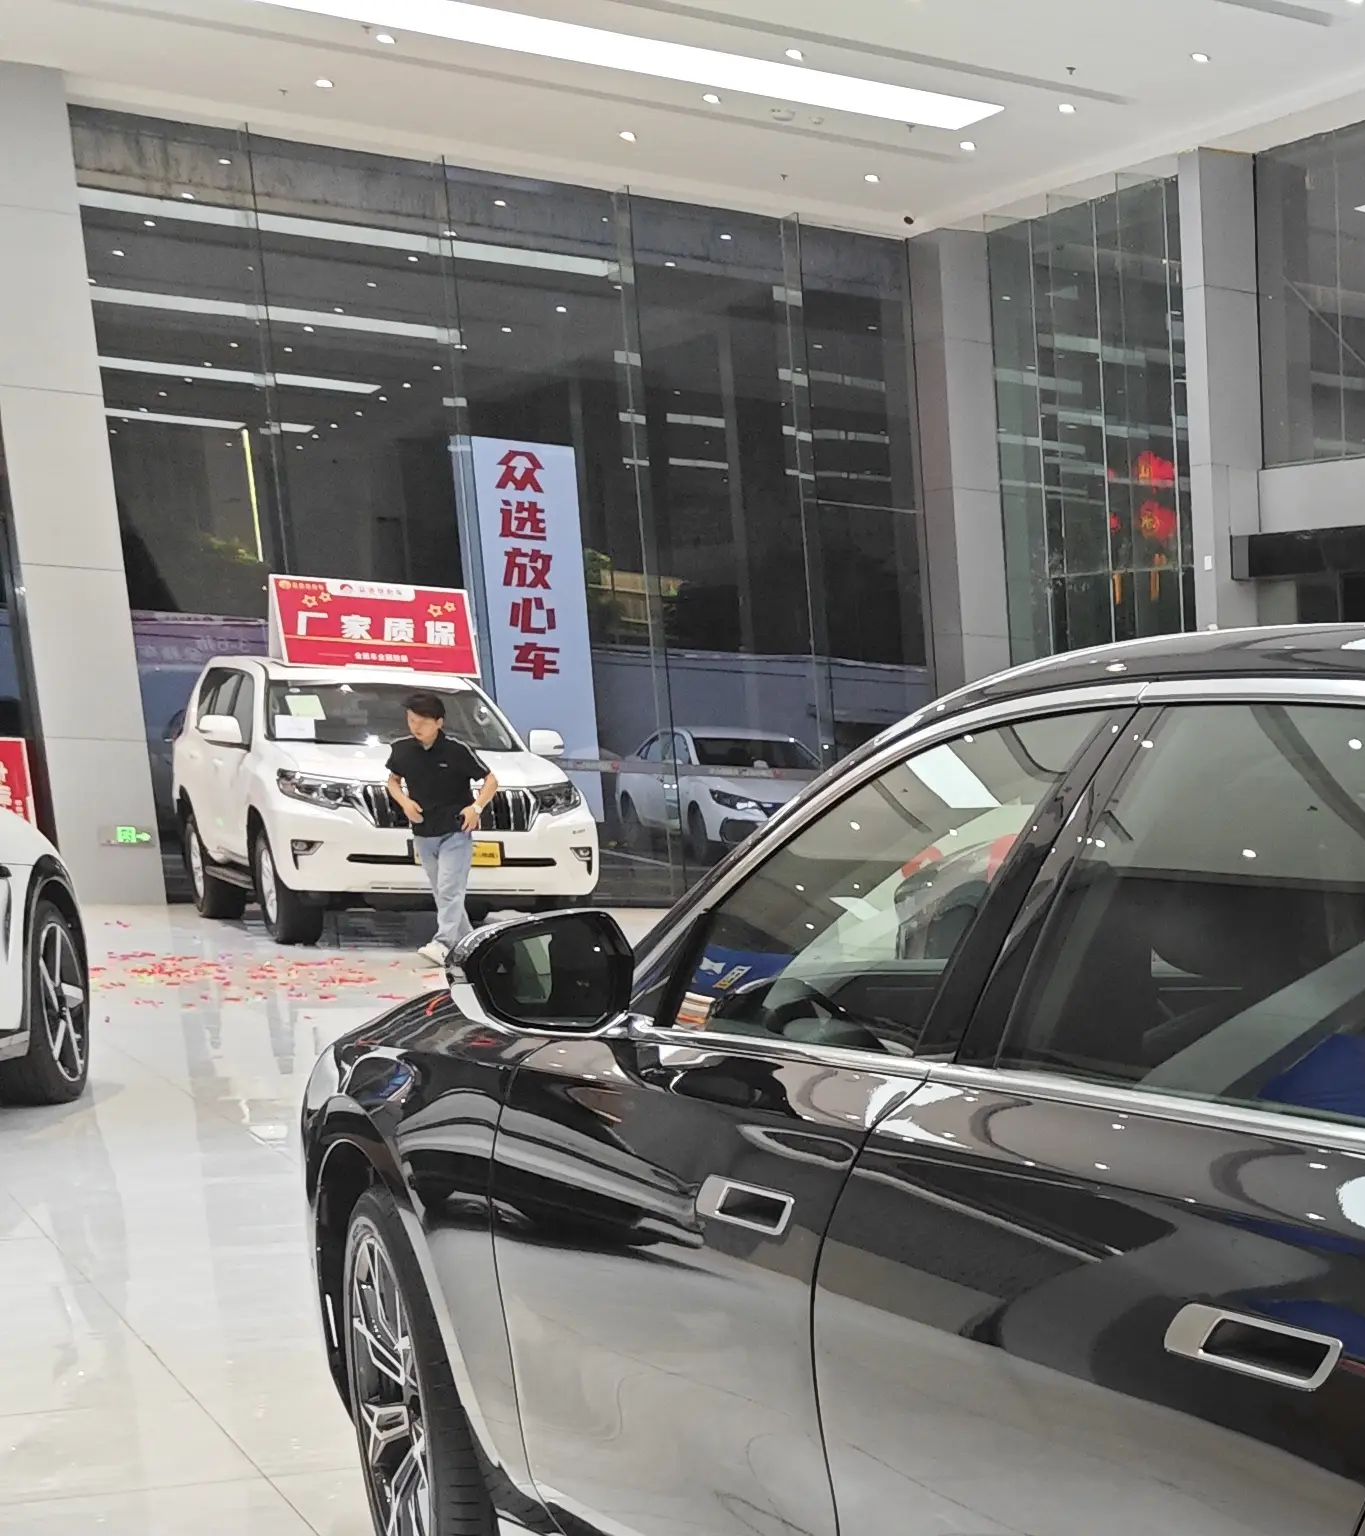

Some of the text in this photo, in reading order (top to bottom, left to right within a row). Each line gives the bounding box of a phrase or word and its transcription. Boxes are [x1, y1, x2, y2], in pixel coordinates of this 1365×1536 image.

[296, 610, 456, 646] 厂家质保
[495, 450, 560, 681] 众选放心车
